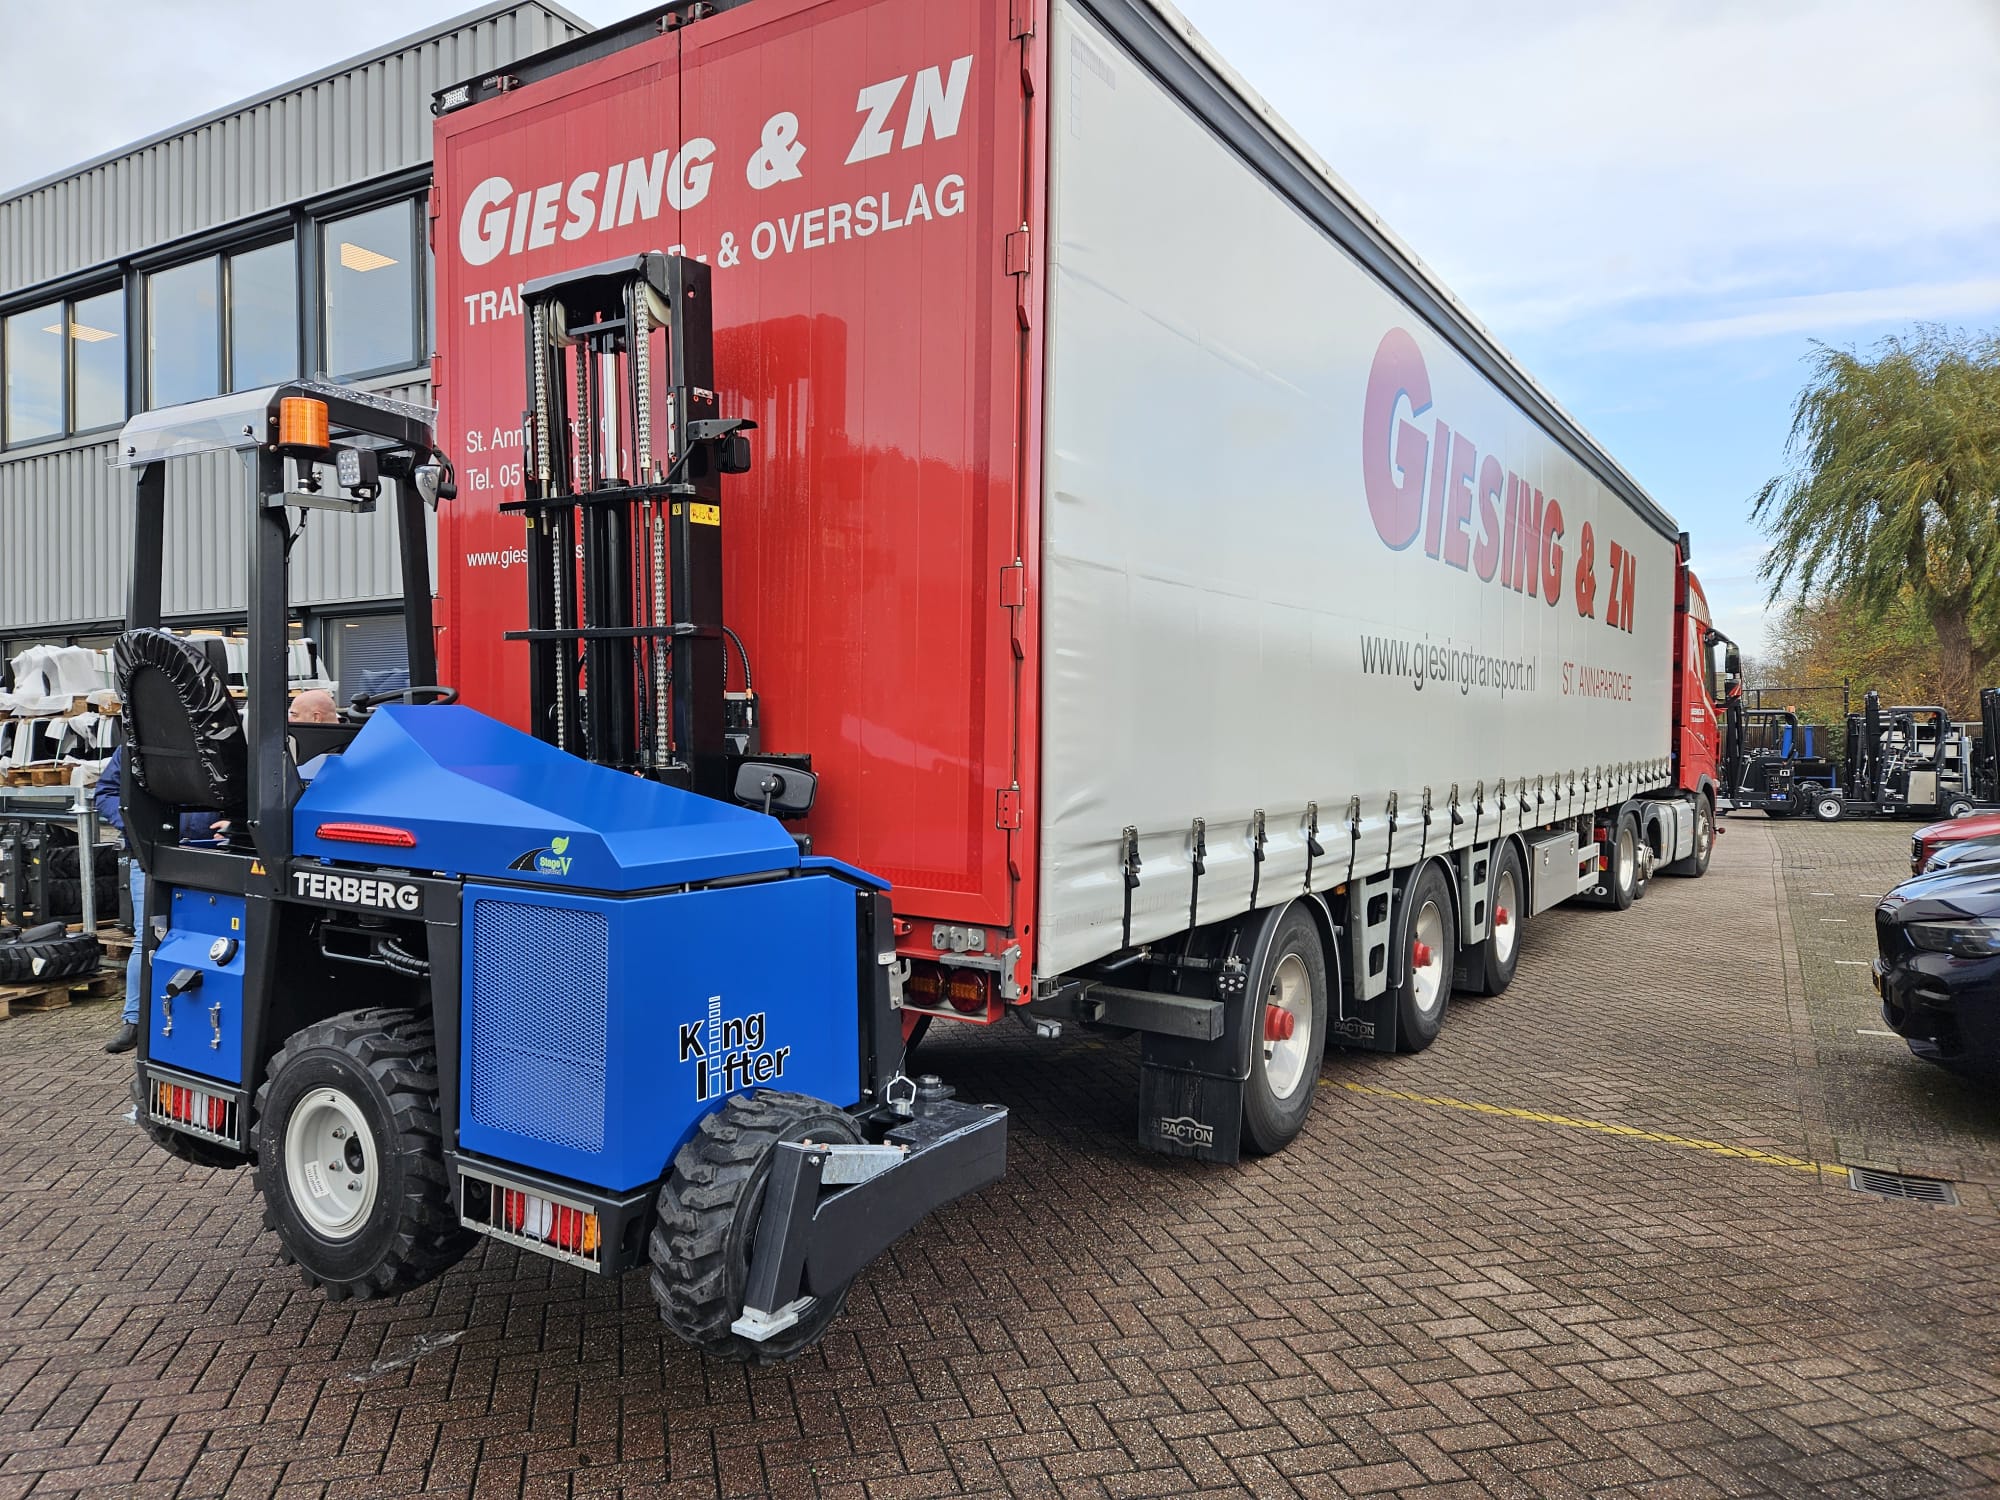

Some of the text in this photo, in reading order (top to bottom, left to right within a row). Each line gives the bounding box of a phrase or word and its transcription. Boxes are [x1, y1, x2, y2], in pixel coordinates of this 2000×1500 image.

[459, 54, 973, 266] GIESING & ZN
[717, 231, 740, 268] &
[750, 173, 966, 260] OVERSLAG
[466, 431, 487, 453] St.
[466, 469, 495, 491] Tel.
[1363, 327, 1637, 634] GIESING & ZN
[1361, 632, 1536, 699] www.giesingtransport.nl
[559, 857, 573, 876] V
[293, 871, 419, 911] TERBERG
[1161, 1122, 1213, 1143] PACTON
